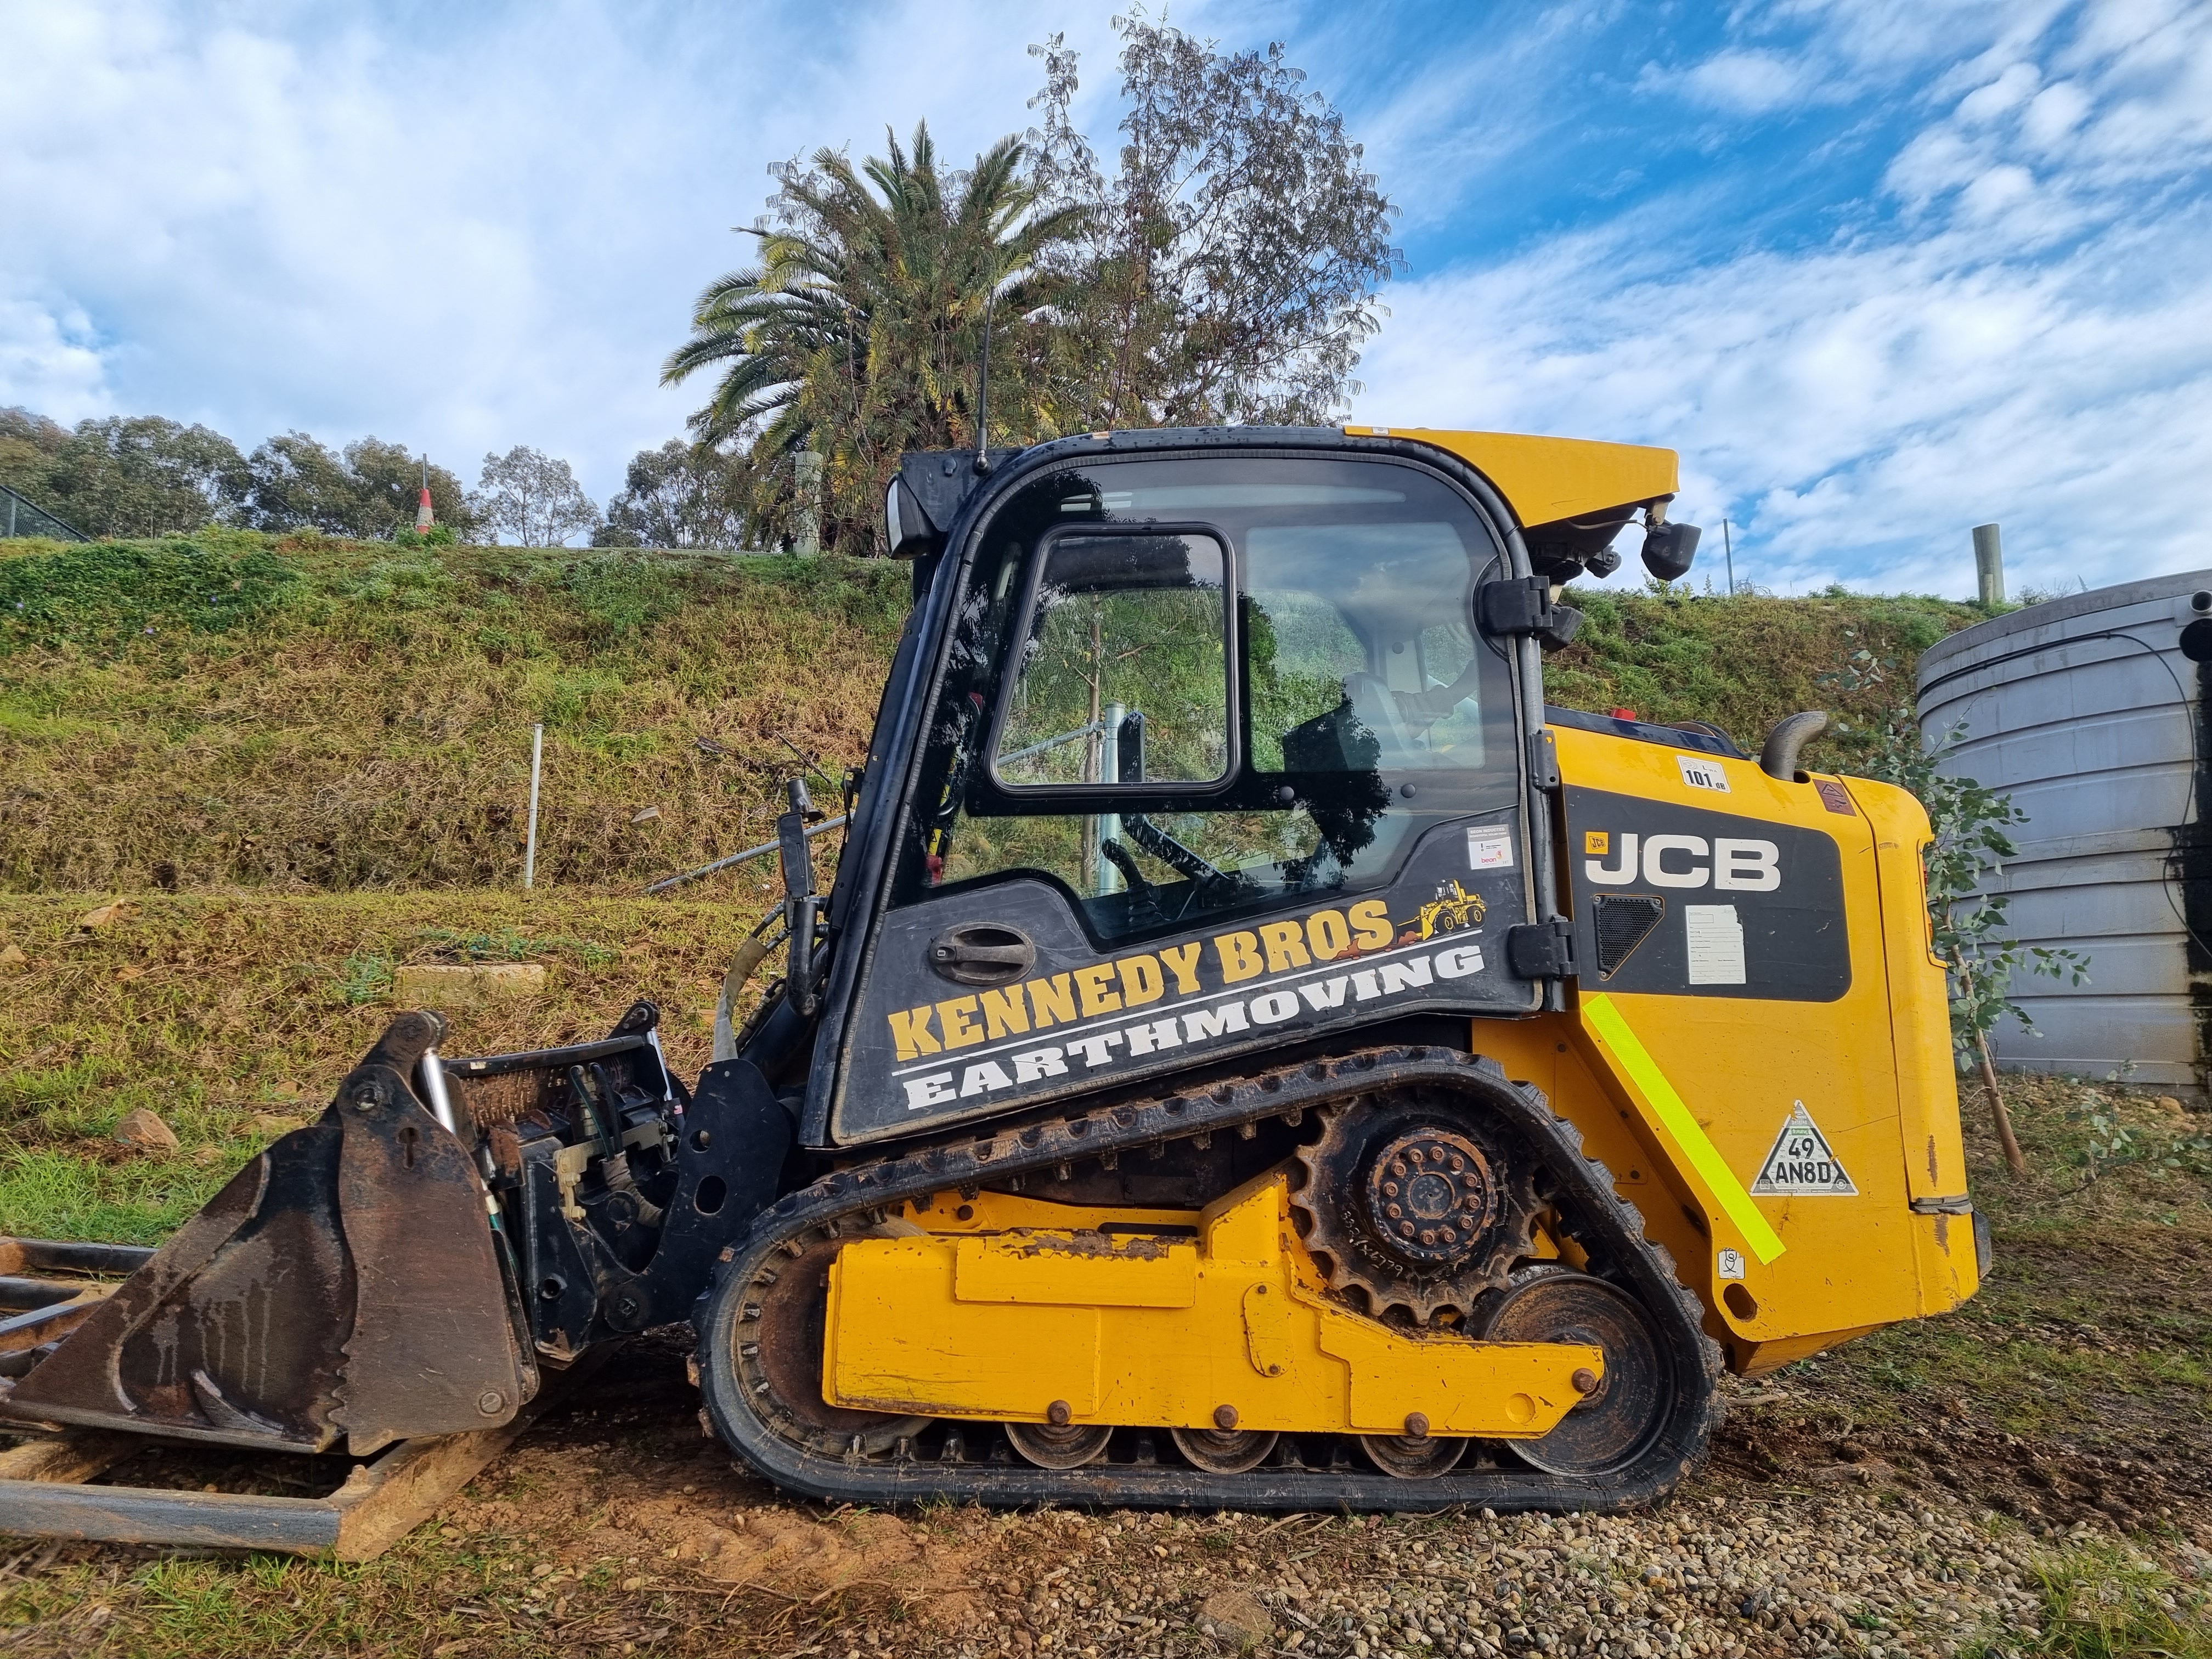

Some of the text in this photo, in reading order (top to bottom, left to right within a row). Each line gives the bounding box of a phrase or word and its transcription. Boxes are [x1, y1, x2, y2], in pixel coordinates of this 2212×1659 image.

[1686, 770, 1726, 790] 101 dB
[1592, 838, 1605, 848] JCB
[1585, 833, 1781, 891] JCB
[888, 900, 1394, 1063] KENNEDY BROS
[902, 945, 1485, 1110] EARTHMOVING
[1788, 1138, 1815, 1160] 49
[1775, 1161, 1831, 1184] AN8D
